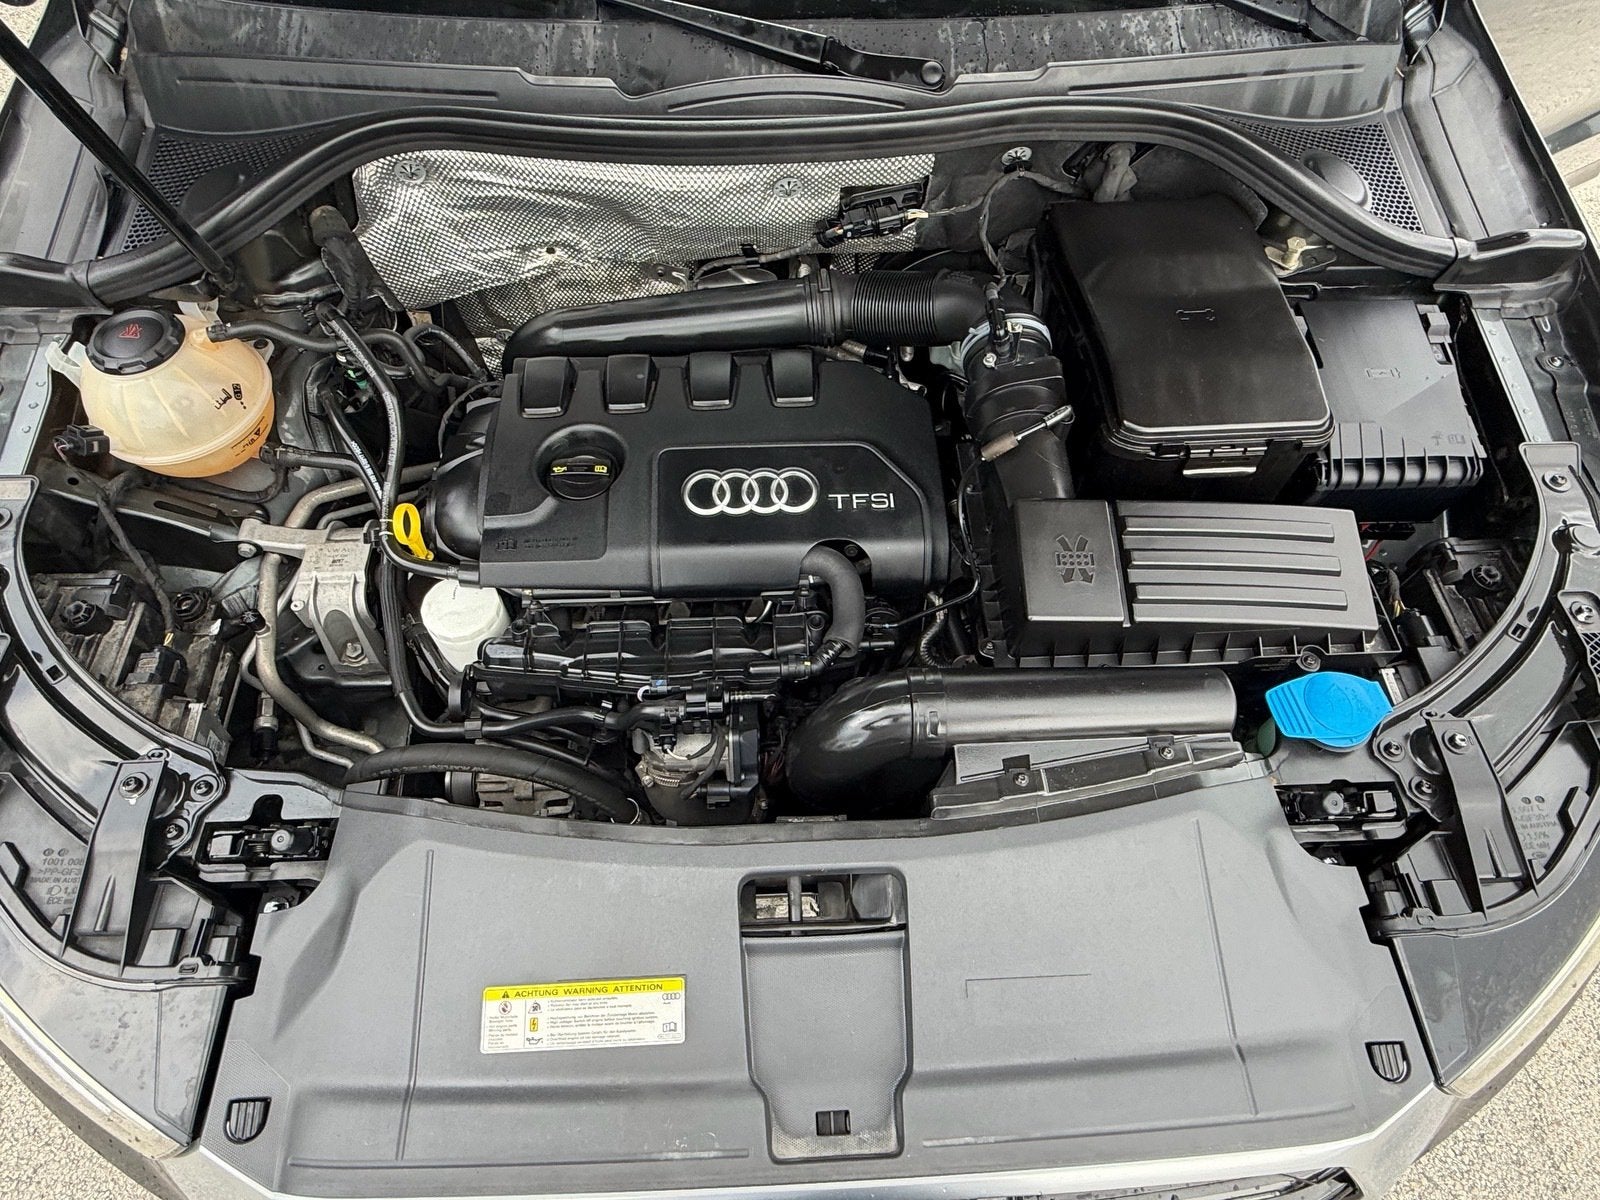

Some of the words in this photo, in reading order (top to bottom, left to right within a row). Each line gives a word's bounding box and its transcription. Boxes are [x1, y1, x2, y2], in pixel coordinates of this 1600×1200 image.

[828, 493, 895, 509] TFSI
[46, 896, 64, 904] ECE
[514, 989, 559, 998] ACHTUNG
[563, 986, 608, 995] WARNING
[613, 983, 664, 993] ATTENTION
